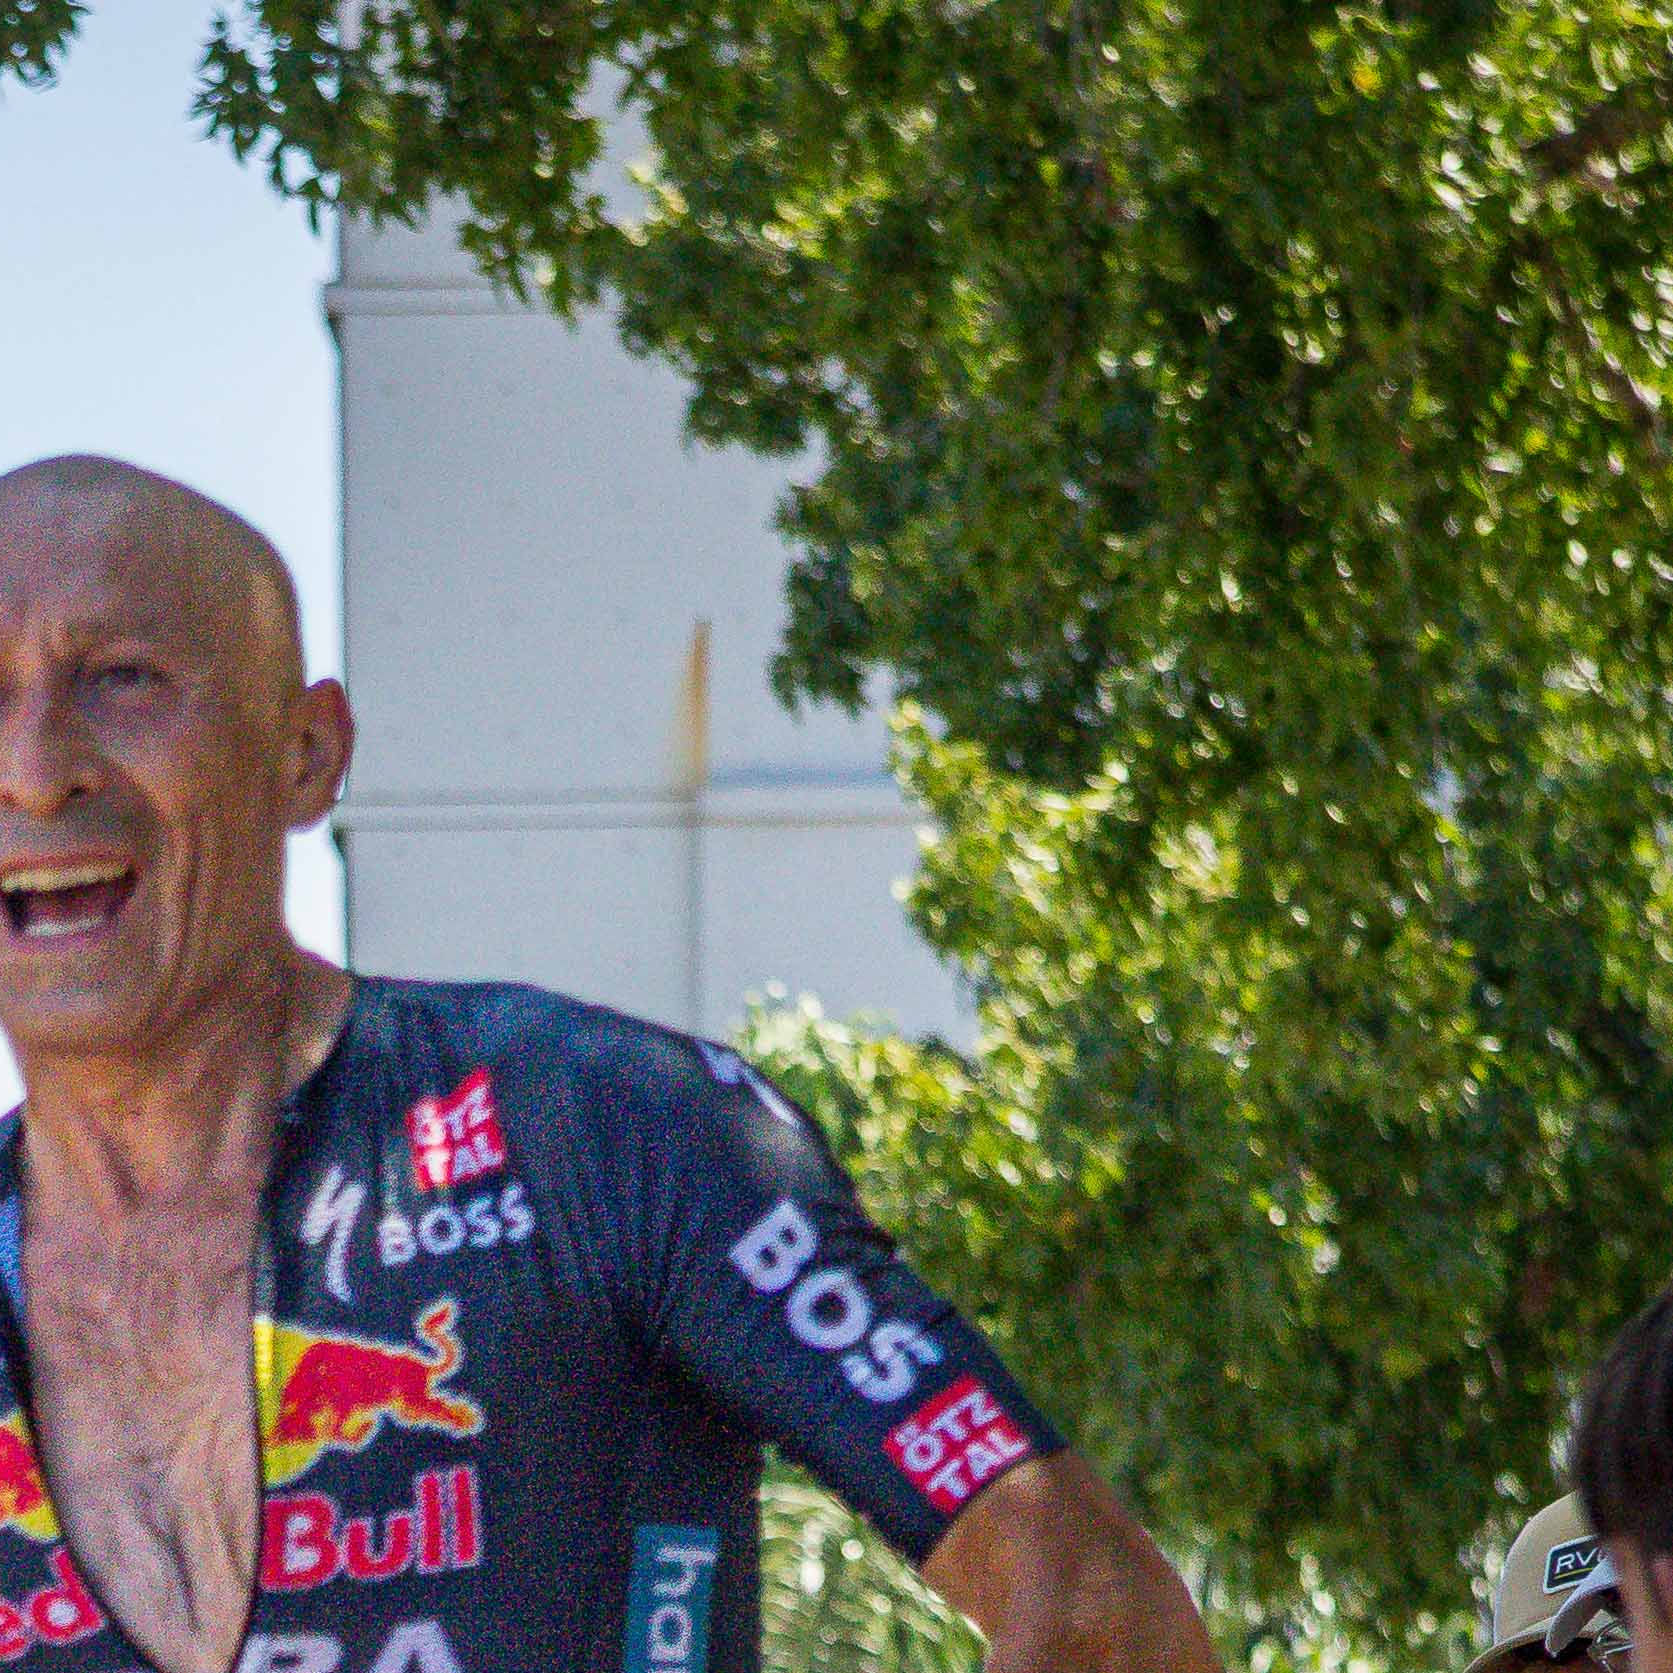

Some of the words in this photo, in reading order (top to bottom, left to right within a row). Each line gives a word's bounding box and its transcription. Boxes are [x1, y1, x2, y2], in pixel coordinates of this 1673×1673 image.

[378, 1183, 535, 1268] BOSS
[895, 1390, 1002, 1473] ÖTZ
[926, 1427, 1028, 1499] TAL
[261, 1464, 485, 1593] Bull
